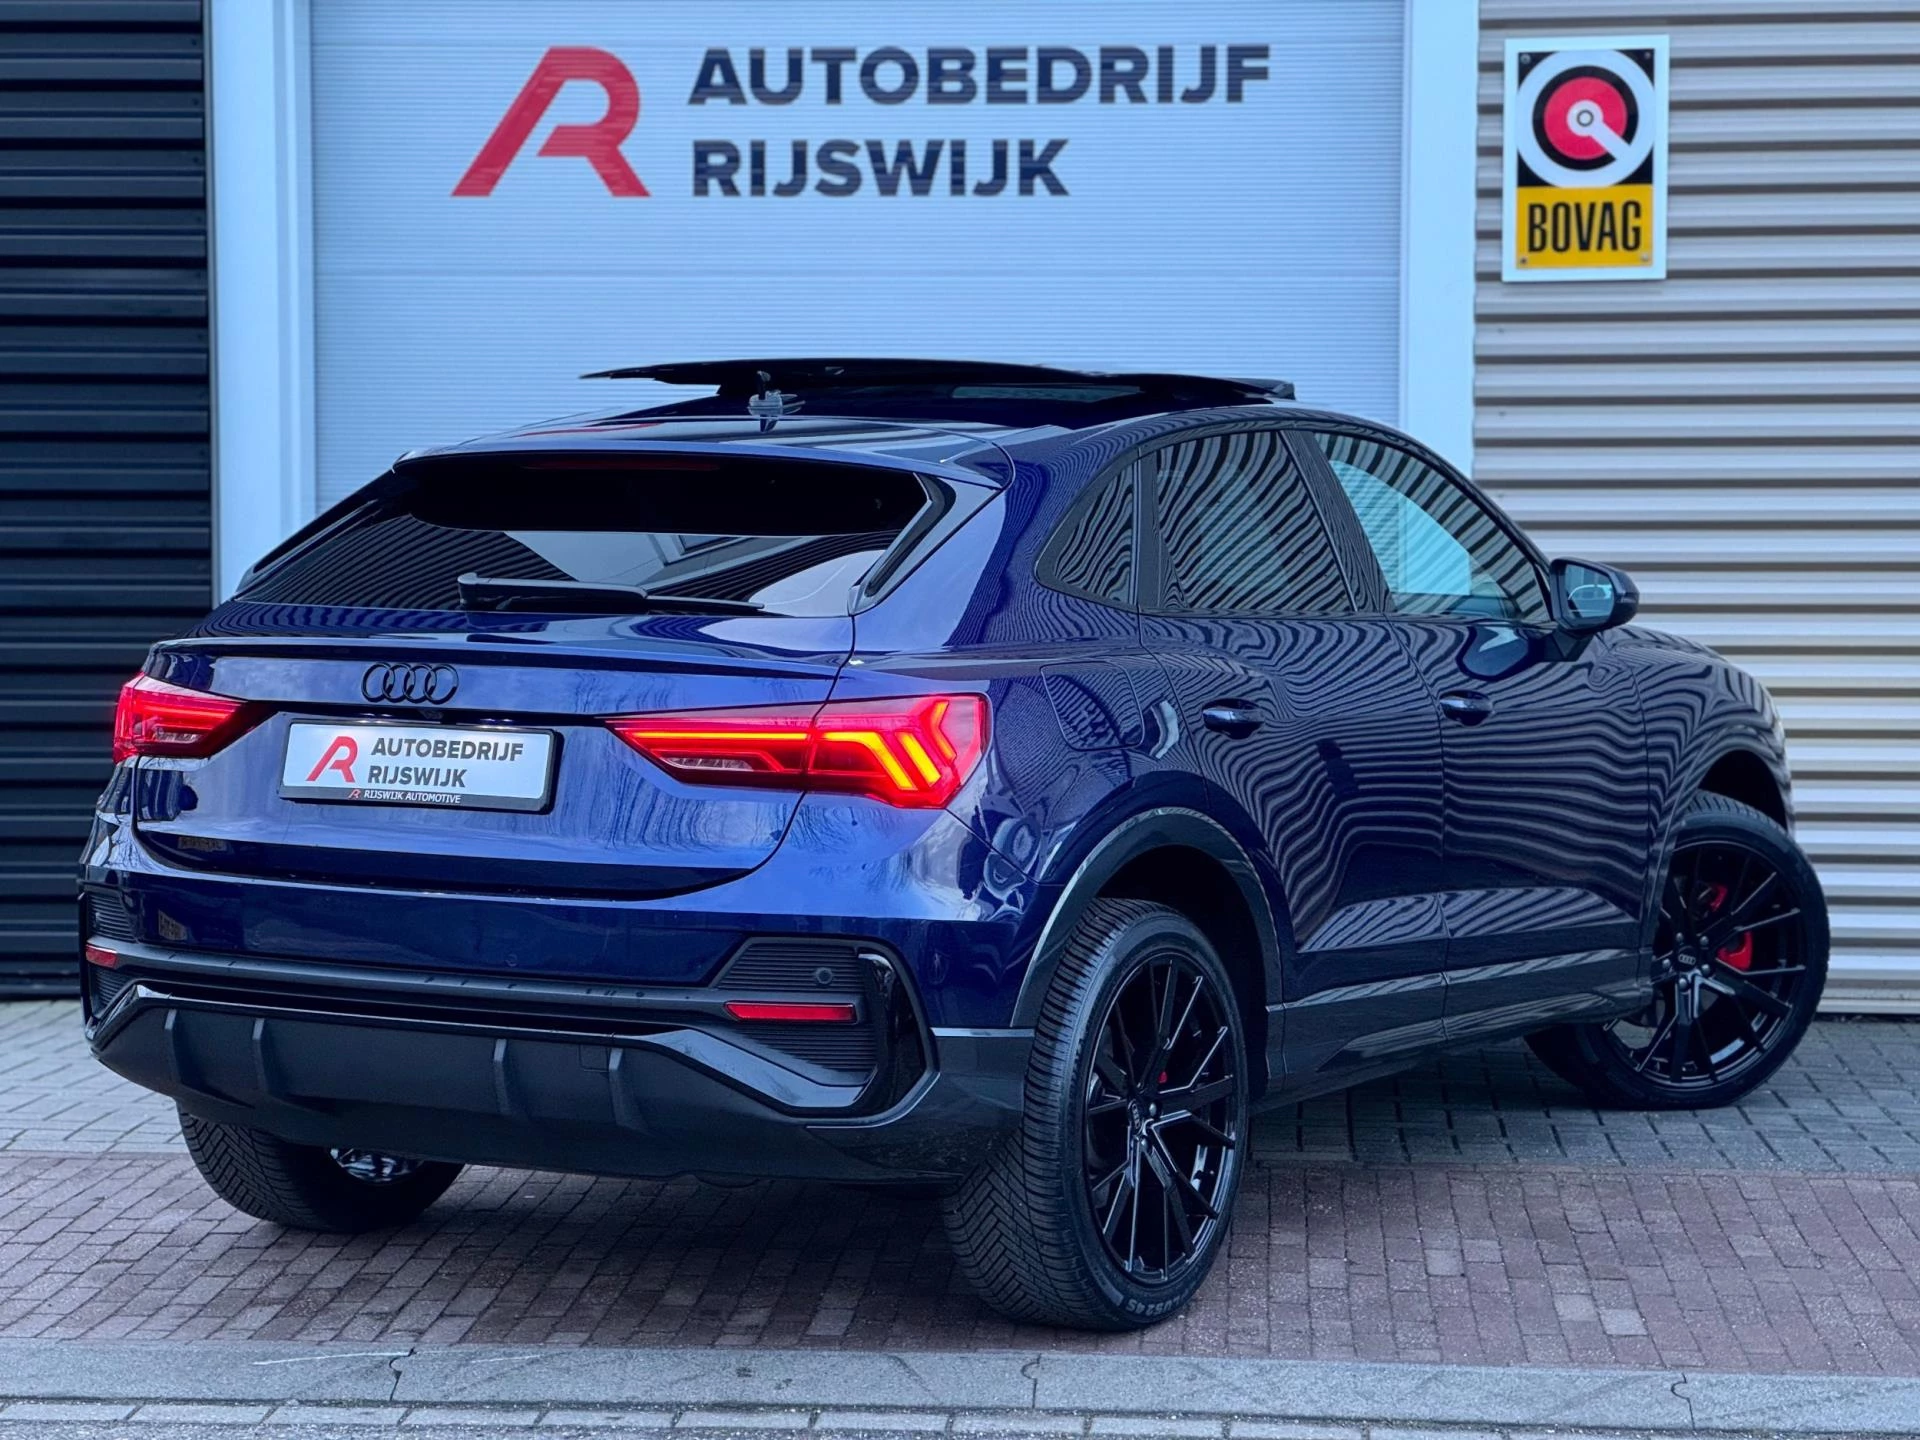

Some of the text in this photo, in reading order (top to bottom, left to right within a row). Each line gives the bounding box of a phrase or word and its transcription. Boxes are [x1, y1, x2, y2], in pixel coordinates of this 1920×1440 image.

[688, 45, 1270, 104] AUTOBEDRIJF
[692, 138, 1070, 197] RIJSWIJK
[1527, 200, 1642, 253] BOVAG
[371, 738, 523, 761] AUTOBEDRIJF
[368, 766, 467, 787] RIJSWIJK
[364, 790, 461, 803] RIJSWIJK AUTOMOTIVE
